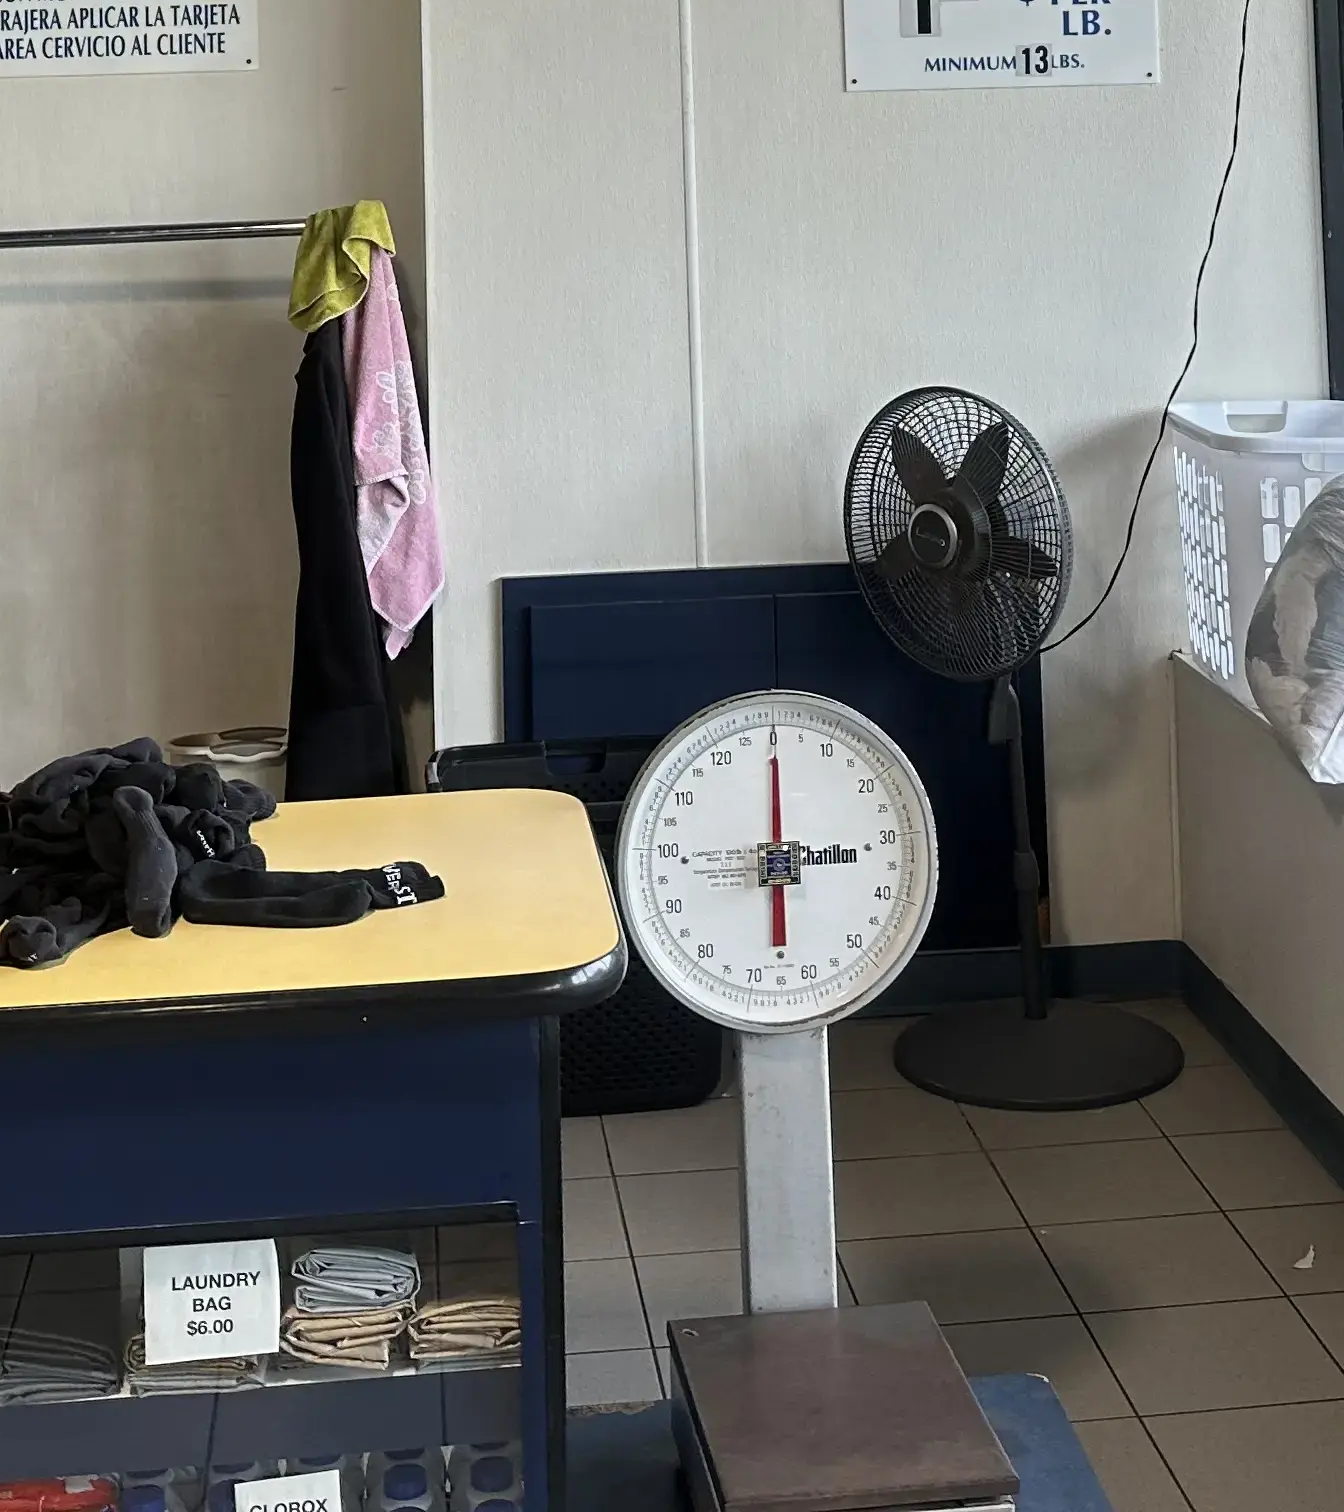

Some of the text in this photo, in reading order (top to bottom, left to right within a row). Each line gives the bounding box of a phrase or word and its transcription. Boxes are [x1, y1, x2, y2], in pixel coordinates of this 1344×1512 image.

[67, 7, 139, 29] APLICAR
[145, 6, 165, 27] LA
[170, 4, 240, 29] TARJETA
[1062, 10, 1111, 36] LB.
[42, 36, 125, 58] CERVICIO
[131, 34, 151, 56] AL
[157, 32, 225, 54] CLIENTE
[924, 45, 1085, 74] MINIMUM 13 LBS.
[738, 737, 752, 746] 125
[770, 732, 777, 745] 0
[798, 734, 804, 742] 5
[820, 743, 833, 757] 10
[710, 751, 732, 766] 120
[846, 759, 854, 768] 15
[692, 768, 704, 777] 115
[858, 779, 874, 793] 20
[675, 791, 693, 806] 110
[878, 804, 888, 813] 25
[664, 818, 677, 827] 105
[880, 830, 896, 844] 30
[658, 843, 678, 858] 100
[887, 861, 896, 871] 35
[874, 886, 891, 900] 40
[666, 898, 682, 914] 90
[868, 916, 879, 925] 45
[846, 934, 862, 948] 50
[698, 944, 714, 958] 80
[722, 965, 732, 974] 75
[830, 958, 840, 968] 55
[746, 968, 762, 984] 70
[801, 964, 817, 980] 60
[776, 976, 786, 986] 65
[171, 1270, 261, 1292] LAUNDRY
[192, 1295, 232, 1314] BAG
[186, 1318, 234, 1337] $6.00
